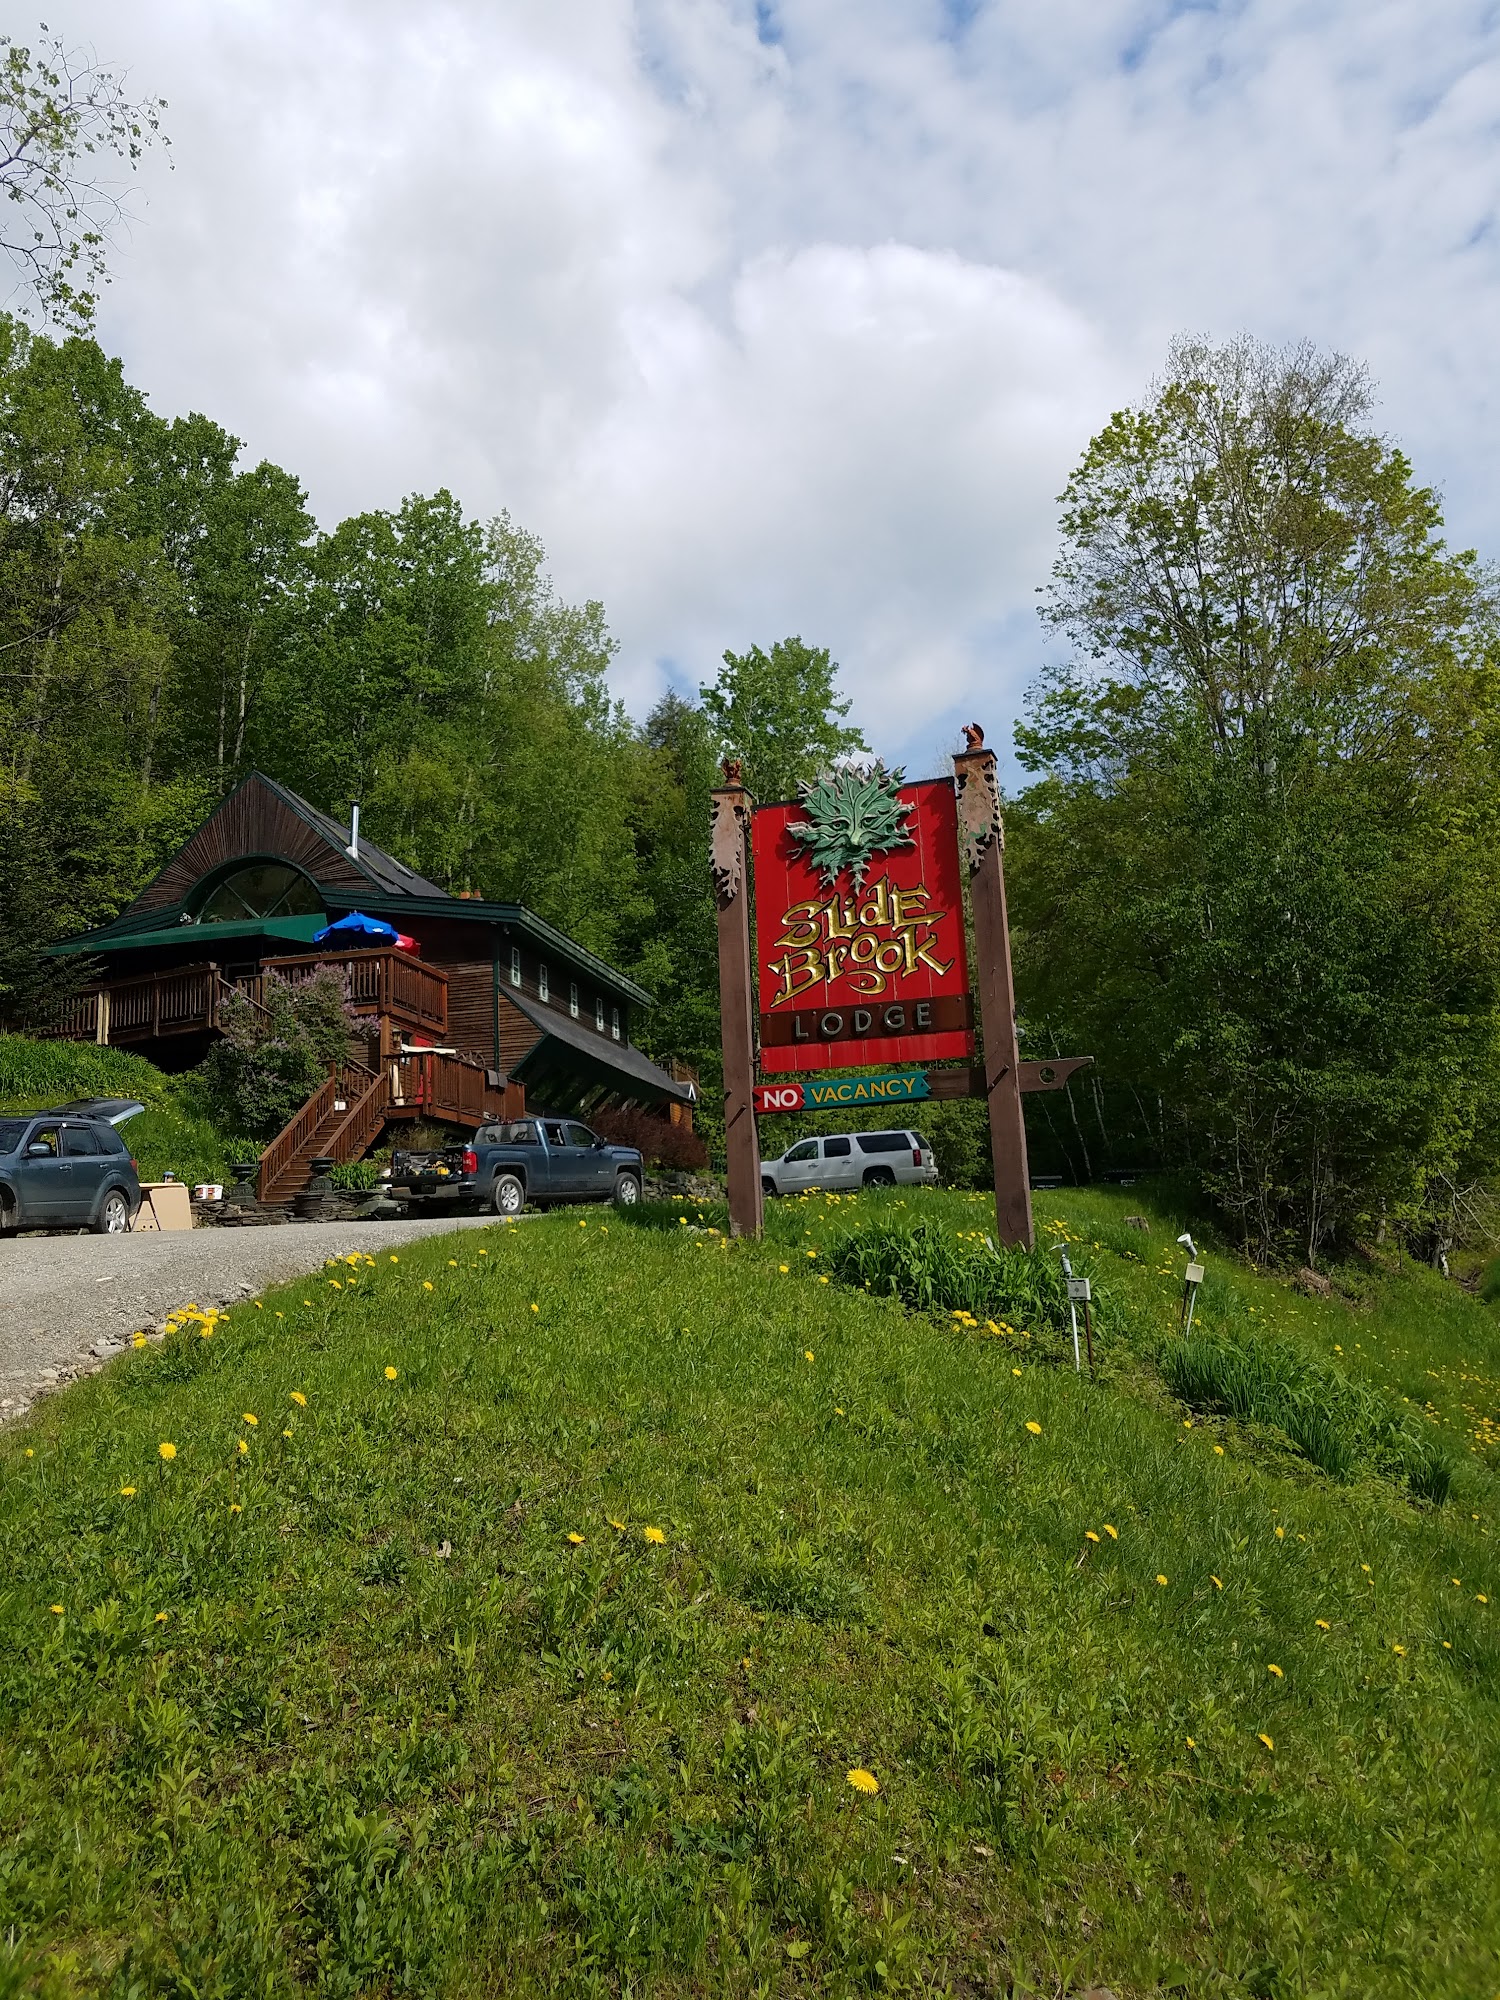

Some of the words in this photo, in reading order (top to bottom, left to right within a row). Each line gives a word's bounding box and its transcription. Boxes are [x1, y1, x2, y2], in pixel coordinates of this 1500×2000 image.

[795, 1003, 932, 1038] LODGE
[763, 1088, 799, 1109] NO
[810, 1077, 916, 1104] VACANCY
